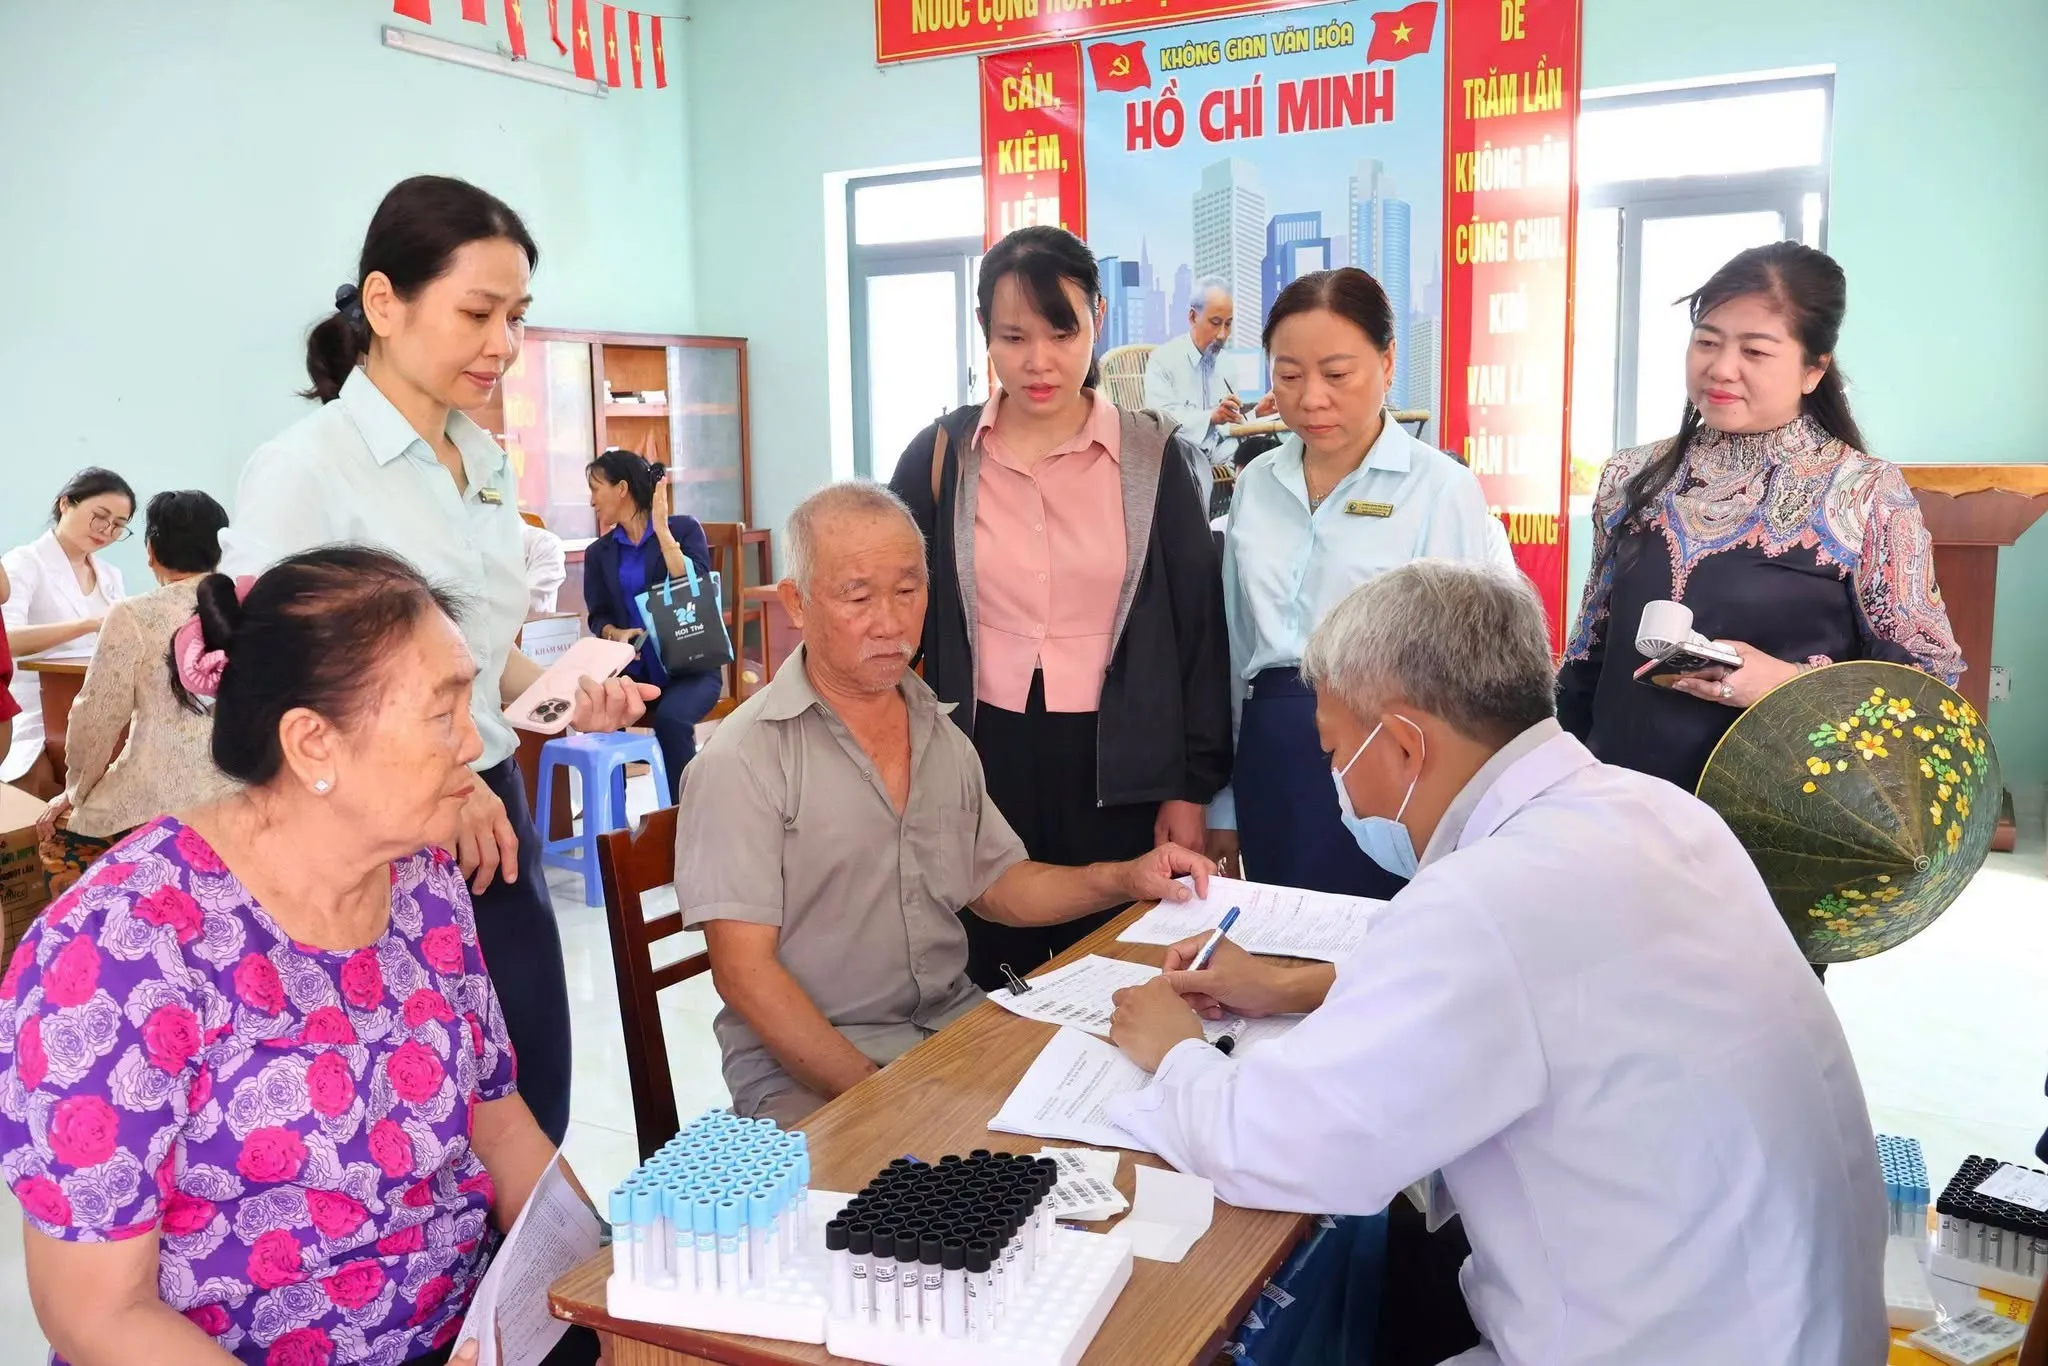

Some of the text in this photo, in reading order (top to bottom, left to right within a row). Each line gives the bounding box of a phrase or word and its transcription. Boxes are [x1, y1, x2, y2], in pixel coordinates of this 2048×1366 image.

[1160, 19, 1354, 71] KHÔNG GIAN VĂN HÓA
[1002, 62, 1061, 113] CẦN,
[1126, 69, 1395, 152] HỒ CHÍ MINH
[1463, 54, 1562, 120] TRĂM LẦN
[998, 130, 1068, 181] KIỆM,
[1455, 140, 1522, 193] KHÔNG
[1456, 214, 1508, 265] CŨNG
[1467, 364, 1506, 415] VẠN
